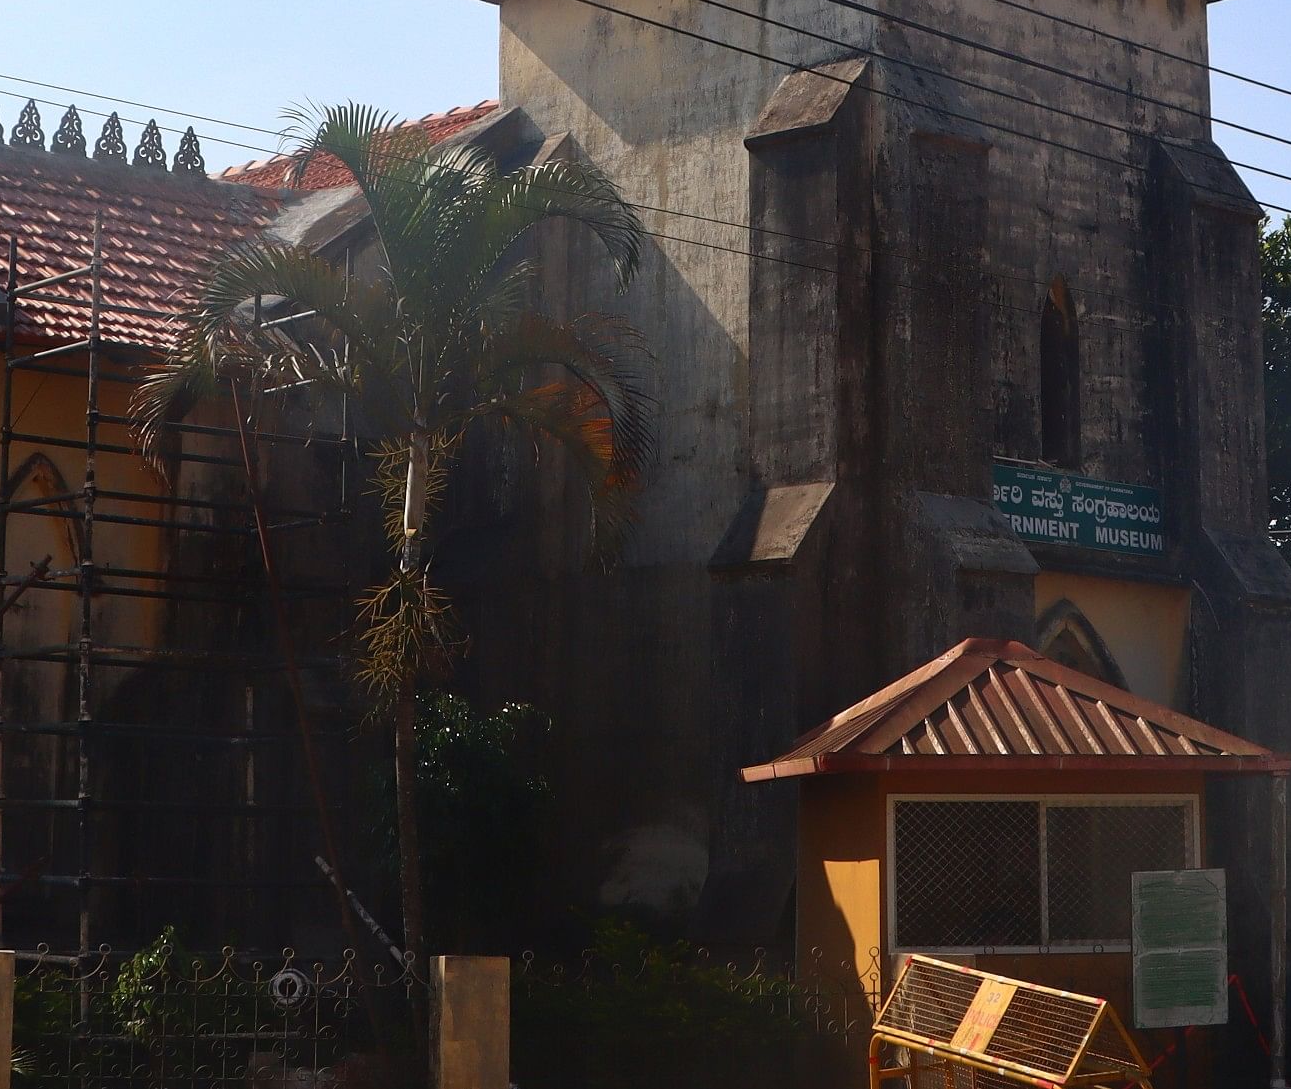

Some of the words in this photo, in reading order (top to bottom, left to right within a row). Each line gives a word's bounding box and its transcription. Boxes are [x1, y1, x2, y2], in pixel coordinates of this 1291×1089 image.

[1031, 486, 1064, 518] ವಸ್ತು
[1071, 491, 1160, 523] ಸಂಗ್ರಹಾಲಯ
[1001, 513, 1079, 539] RNMENT
[1095, 526, 1163, 551] MUSEUM
